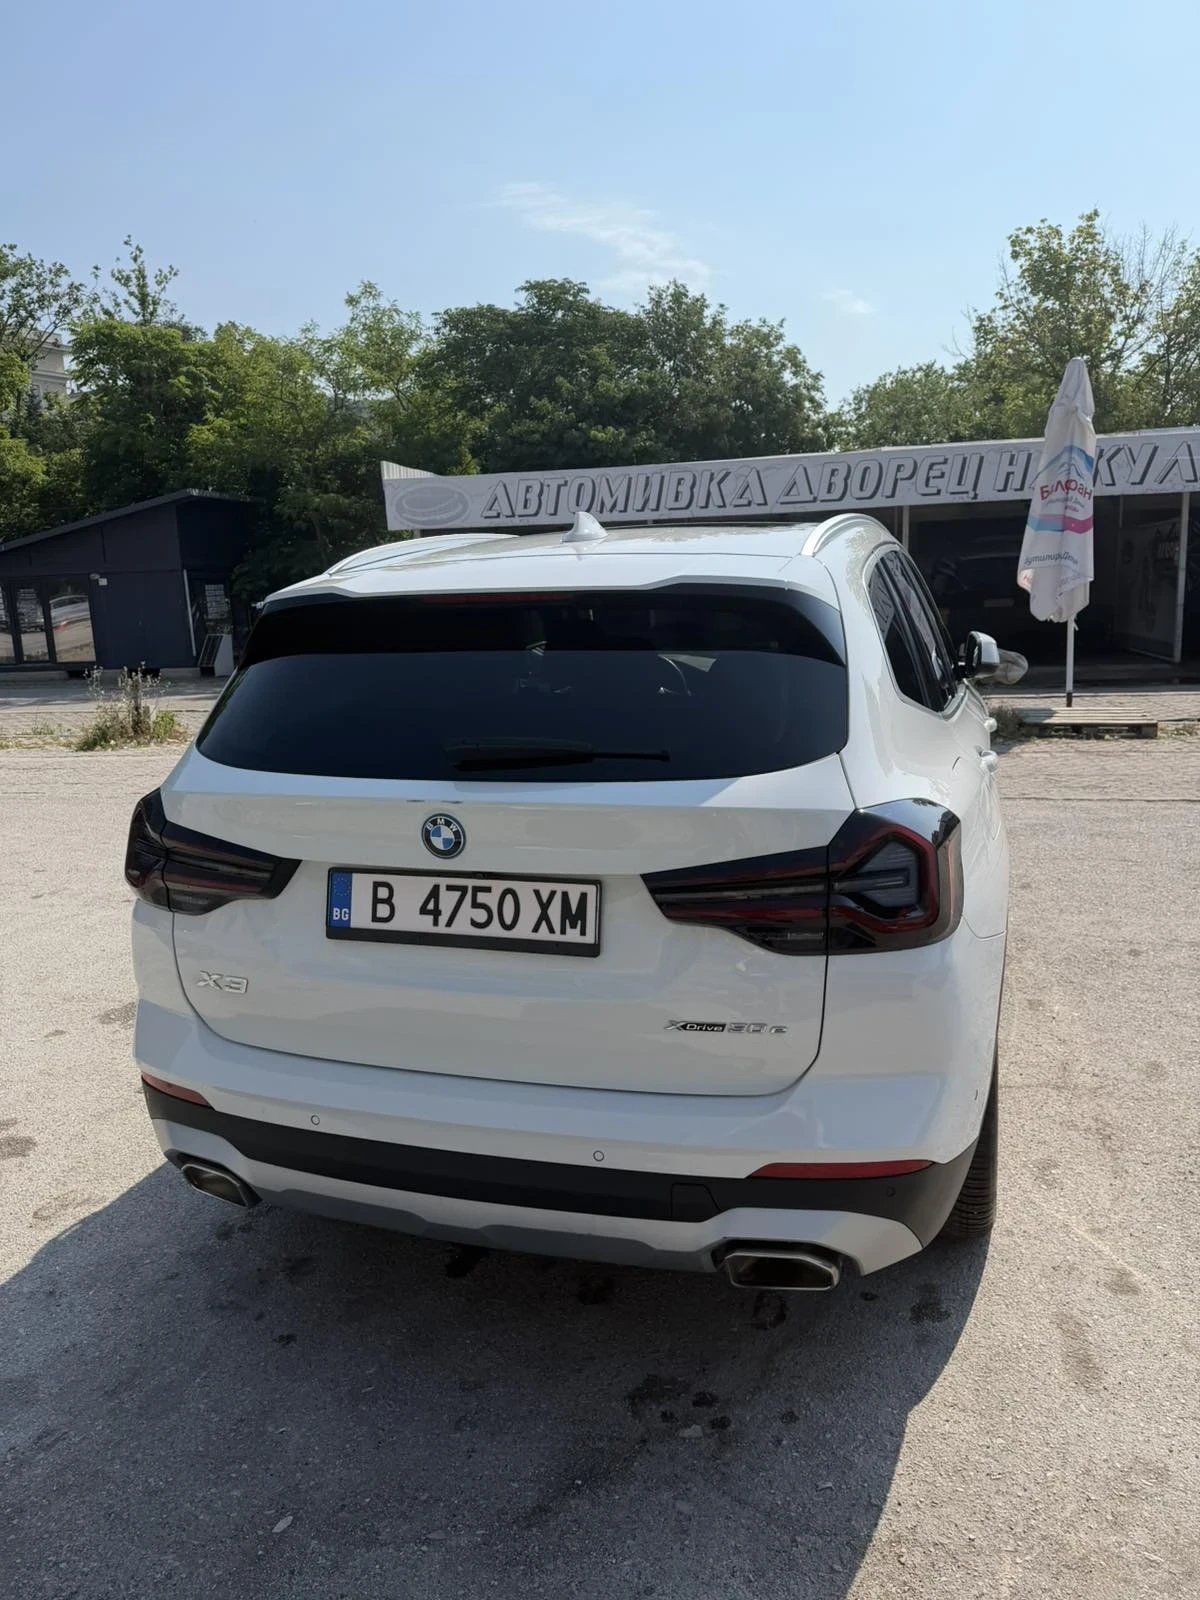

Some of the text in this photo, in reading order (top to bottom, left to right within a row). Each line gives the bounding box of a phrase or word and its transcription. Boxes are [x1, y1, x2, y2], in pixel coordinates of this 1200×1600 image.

[480, 466, 768, 519] АВТОМИВКА
[776, 452, 983, 505] ДВОРЕЦ
[993, 449, 1036, 493] Н
[426, 817, 458, 832] BMW
[332, 907, 350, 921] BG
[370, 881, 588, 937] B 4750 XM
[195, 969, 249, 995] X3
